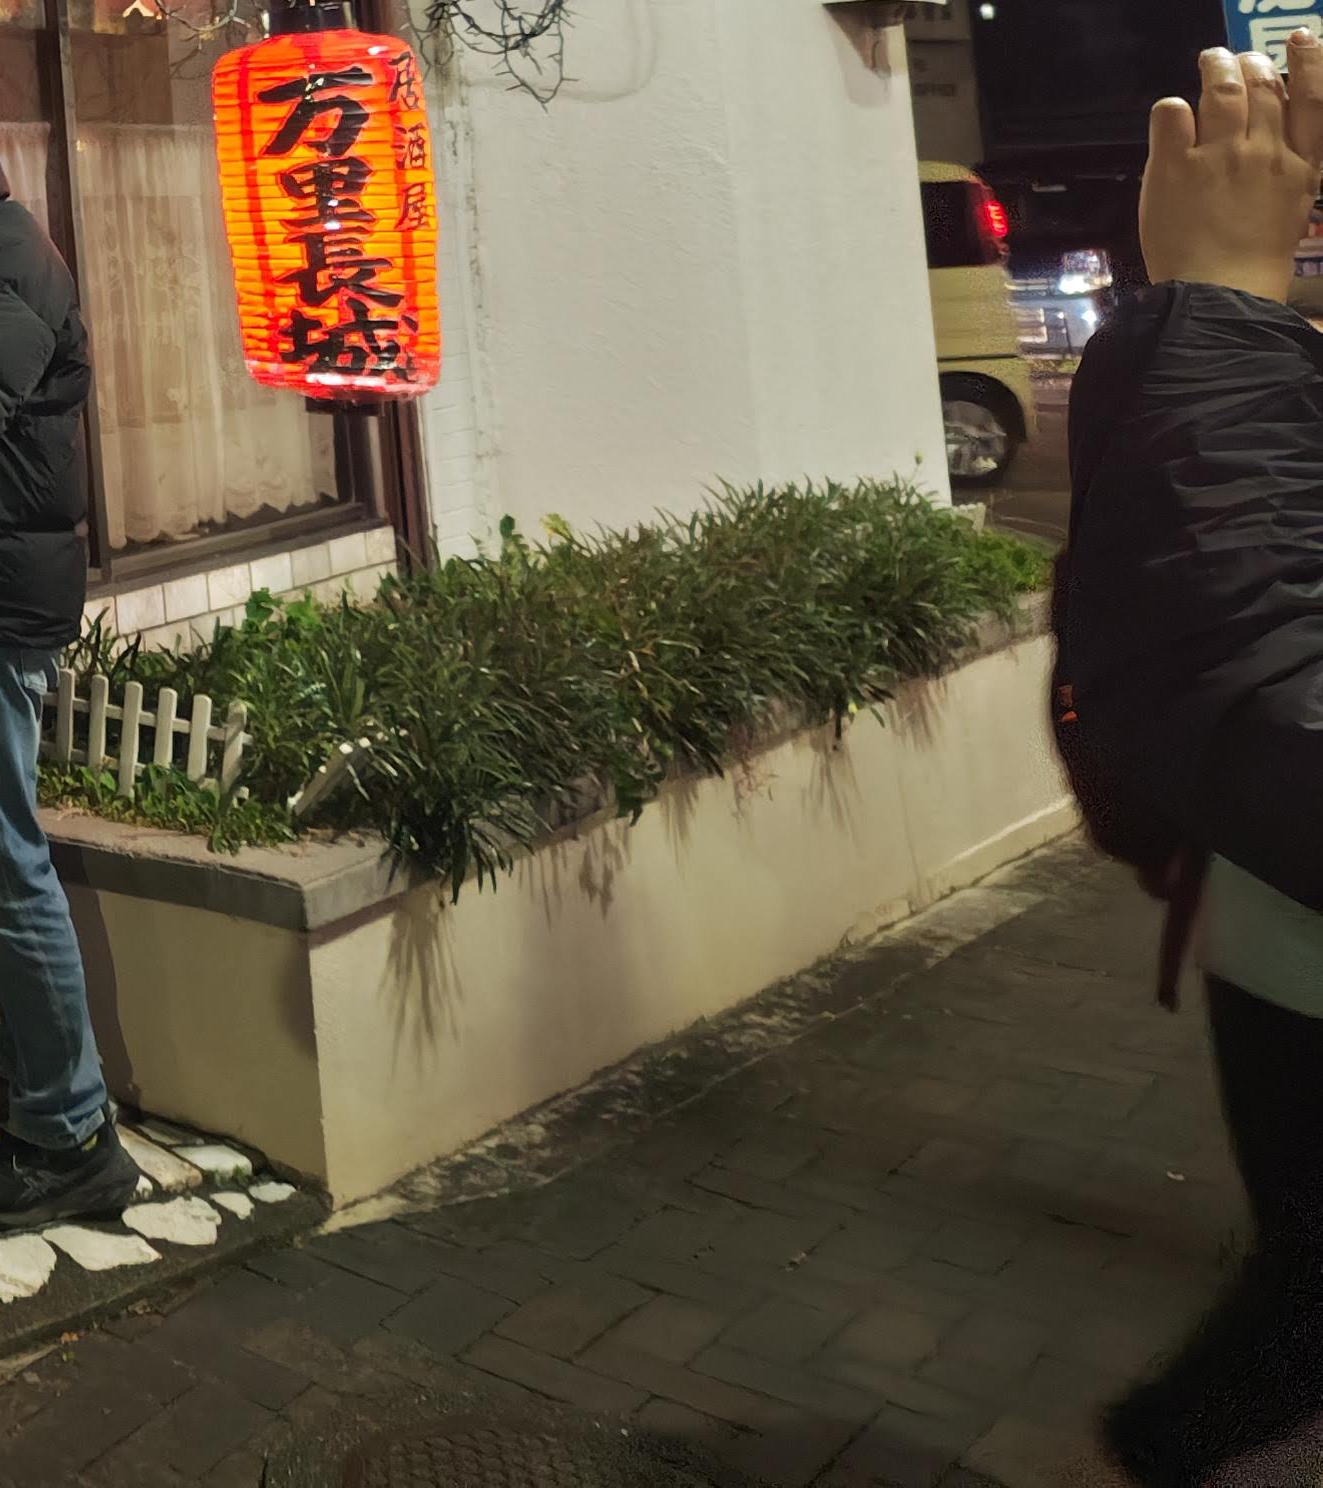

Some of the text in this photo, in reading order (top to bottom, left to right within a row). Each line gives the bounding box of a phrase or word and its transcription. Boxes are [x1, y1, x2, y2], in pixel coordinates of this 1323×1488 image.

[258, 67, 417, 381] 万里長城
[387, 52, 430, 230] 居酒屋
